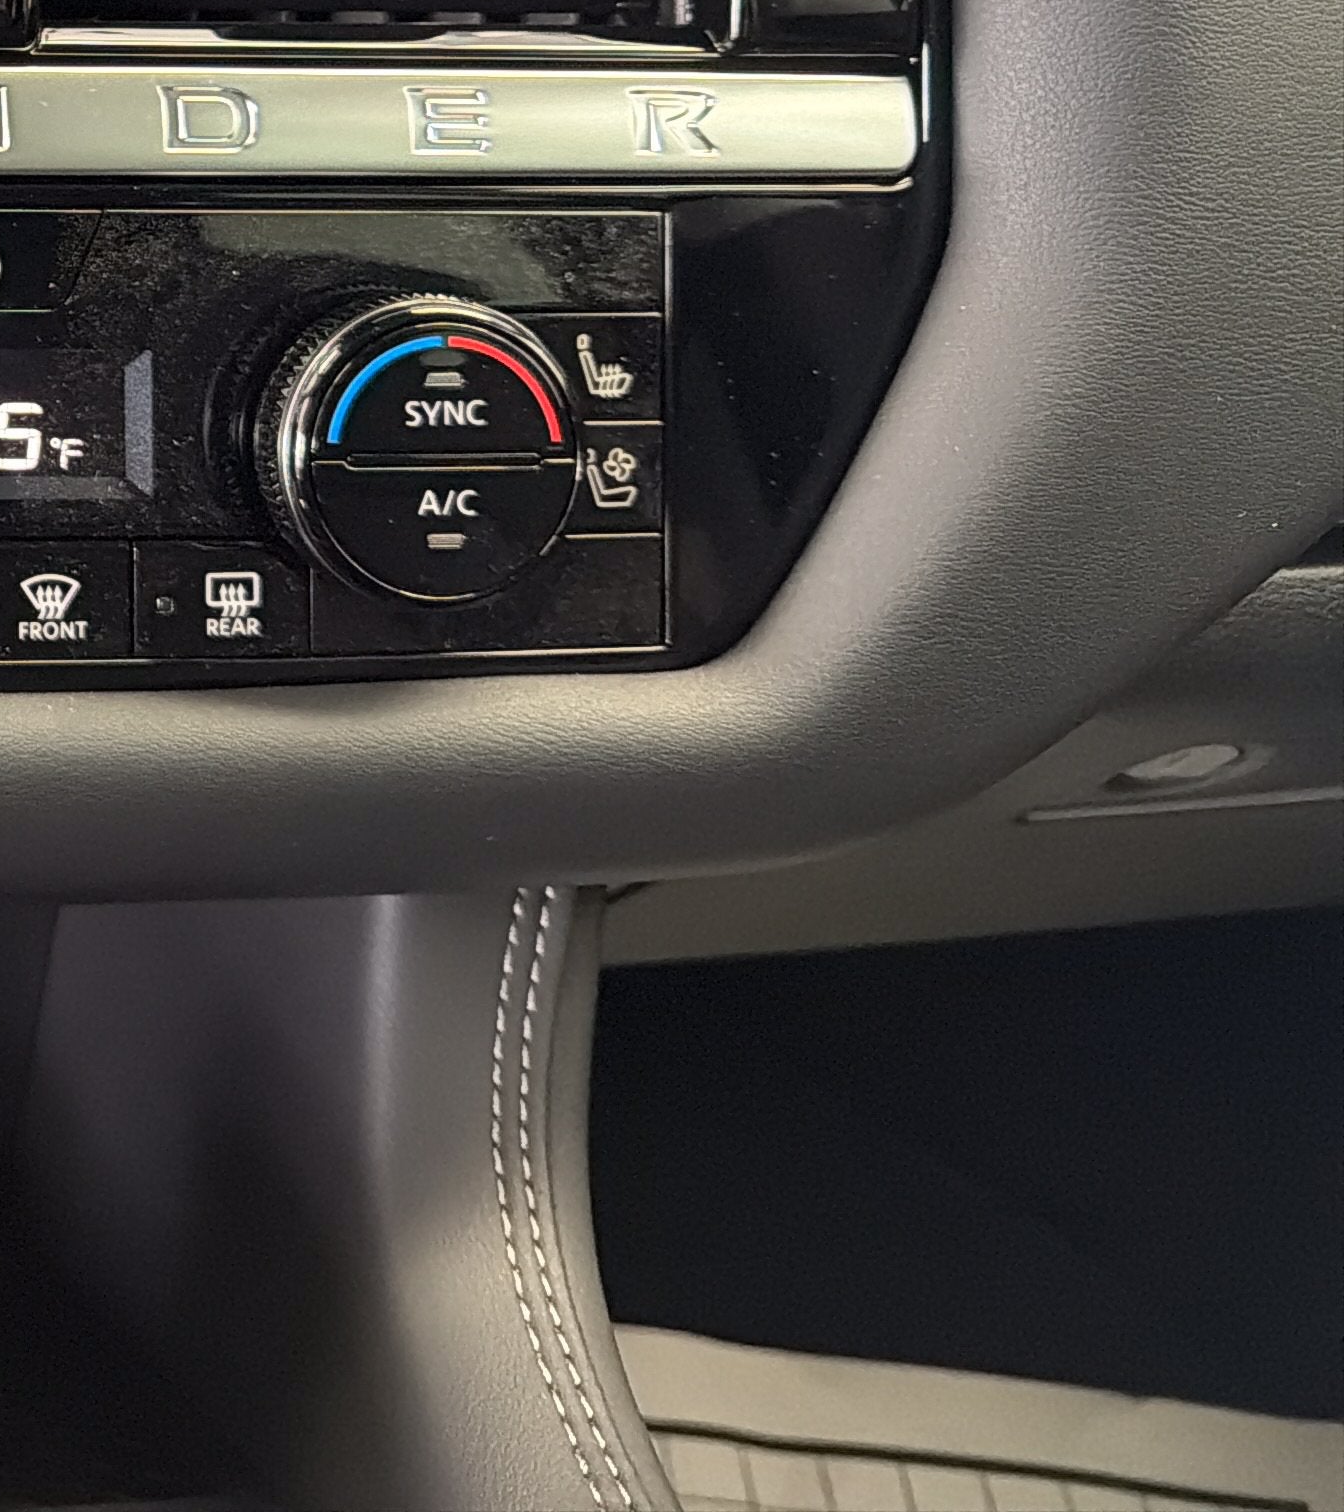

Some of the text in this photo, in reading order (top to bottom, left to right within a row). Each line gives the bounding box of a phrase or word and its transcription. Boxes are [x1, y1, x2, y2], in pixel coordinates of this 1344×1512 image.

[404, 399, 486, 427] SYNC
[417, 489, 477, 516] A/C
[17, 620, 88, 642] FRONT
[205, 617, 261, 637] REAR
